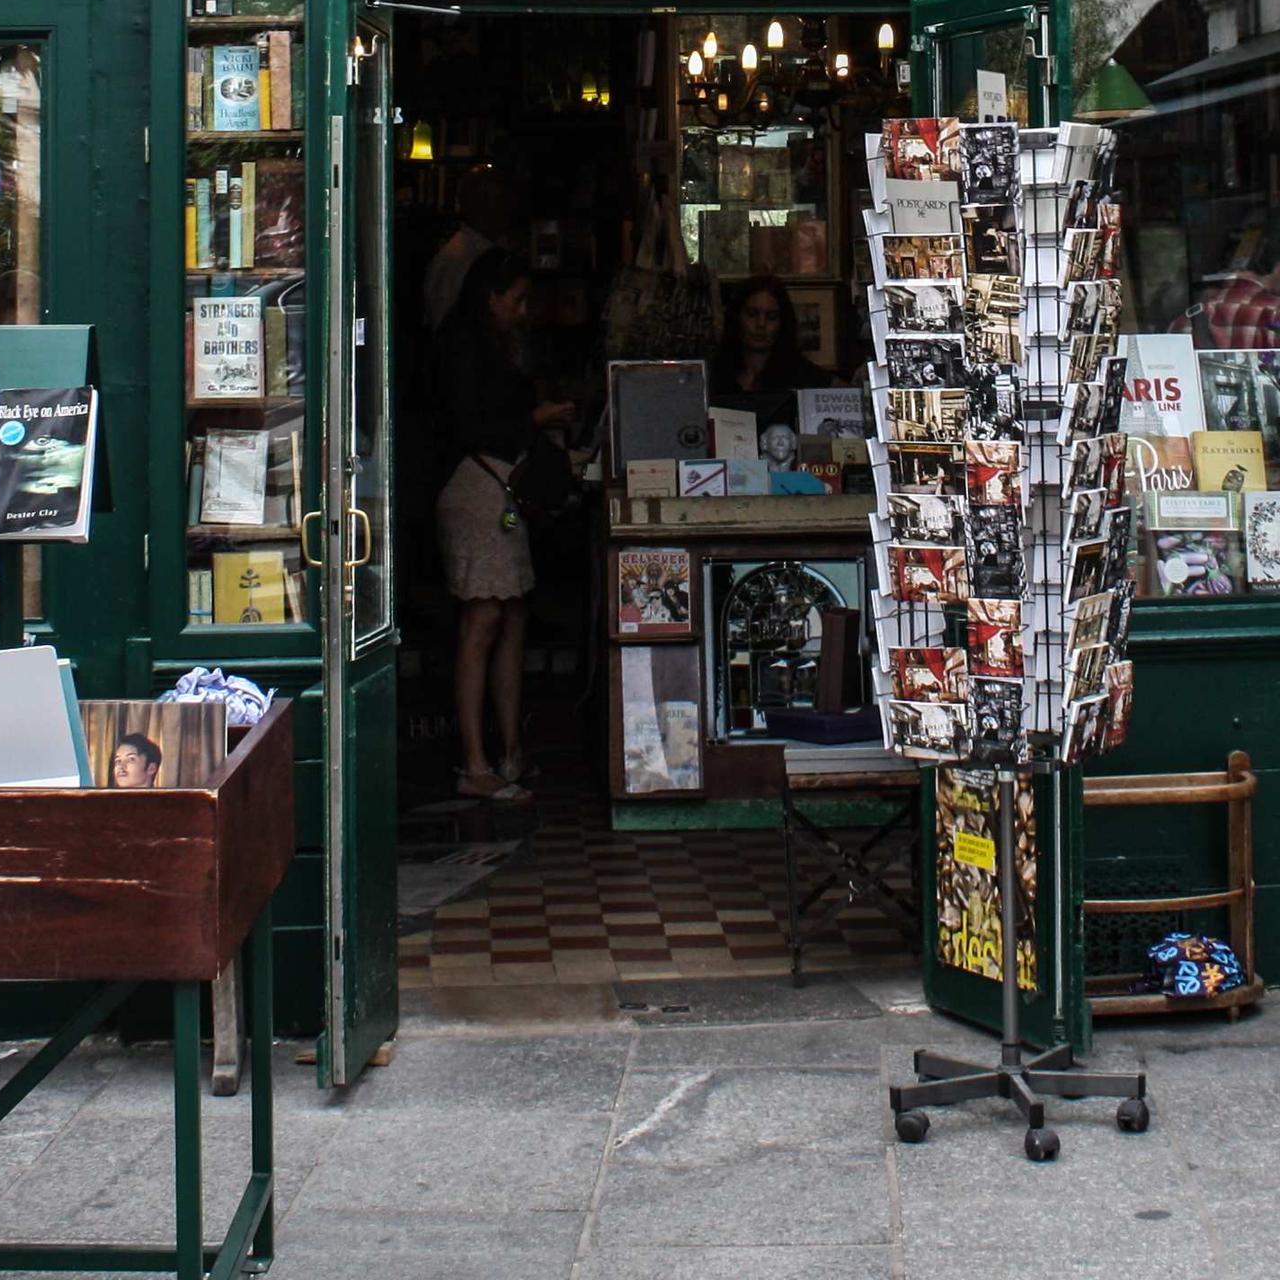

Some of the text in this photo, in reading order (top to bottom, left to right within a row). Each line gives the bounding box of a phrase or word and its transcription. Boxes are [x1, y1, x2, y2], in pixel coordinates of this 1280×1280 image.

[896, 198, 947, 209] POSTCARDS
[203, 340, 258, 355] BROTHERS
[23, 403, 39, 421] Eye
[40, 405, 52, 418] on
[53, 403, 89, 418] America
[1127, 436, 1195, 493] Paris
[38, 507, 59, 518] Clay
